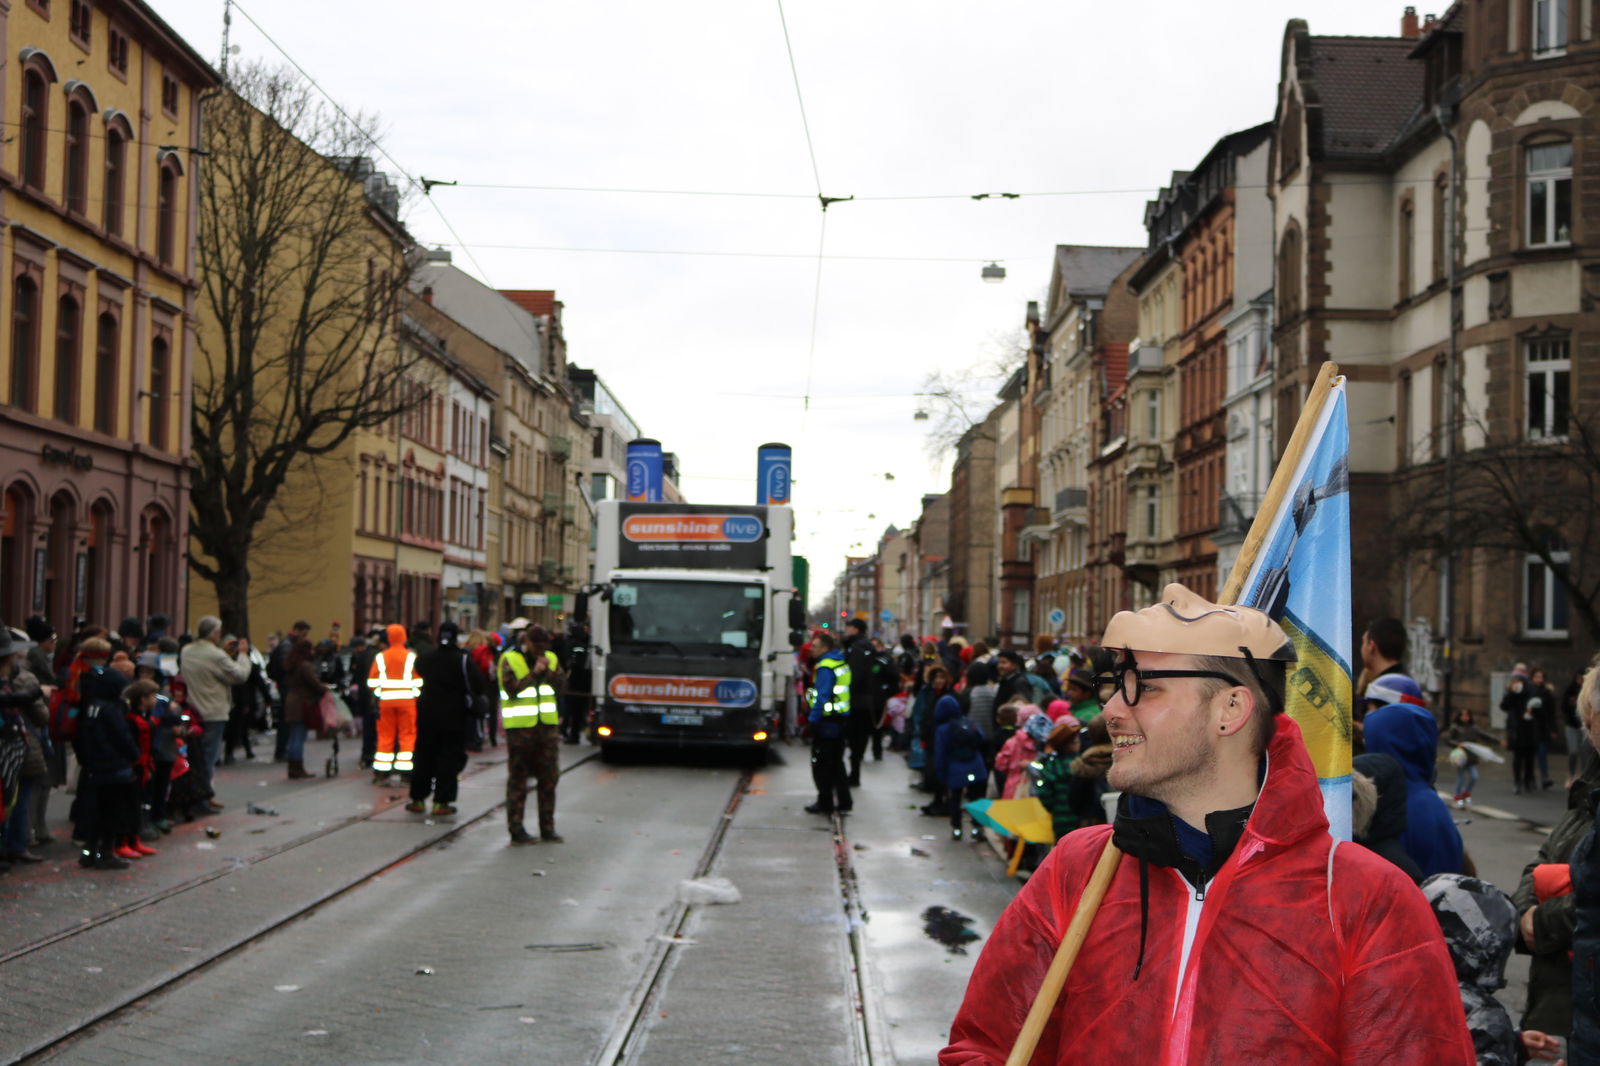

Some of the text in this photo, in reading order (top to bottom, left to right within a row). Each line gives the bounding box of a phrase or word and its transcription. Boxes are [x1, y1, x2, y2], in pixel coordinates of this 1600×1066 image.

[631, 465, 642, 494] live
[773, 468, 786, 498] live
[629, 520, 758, 535] sunshine live
[615, 683, 753, 698] sunshine live
